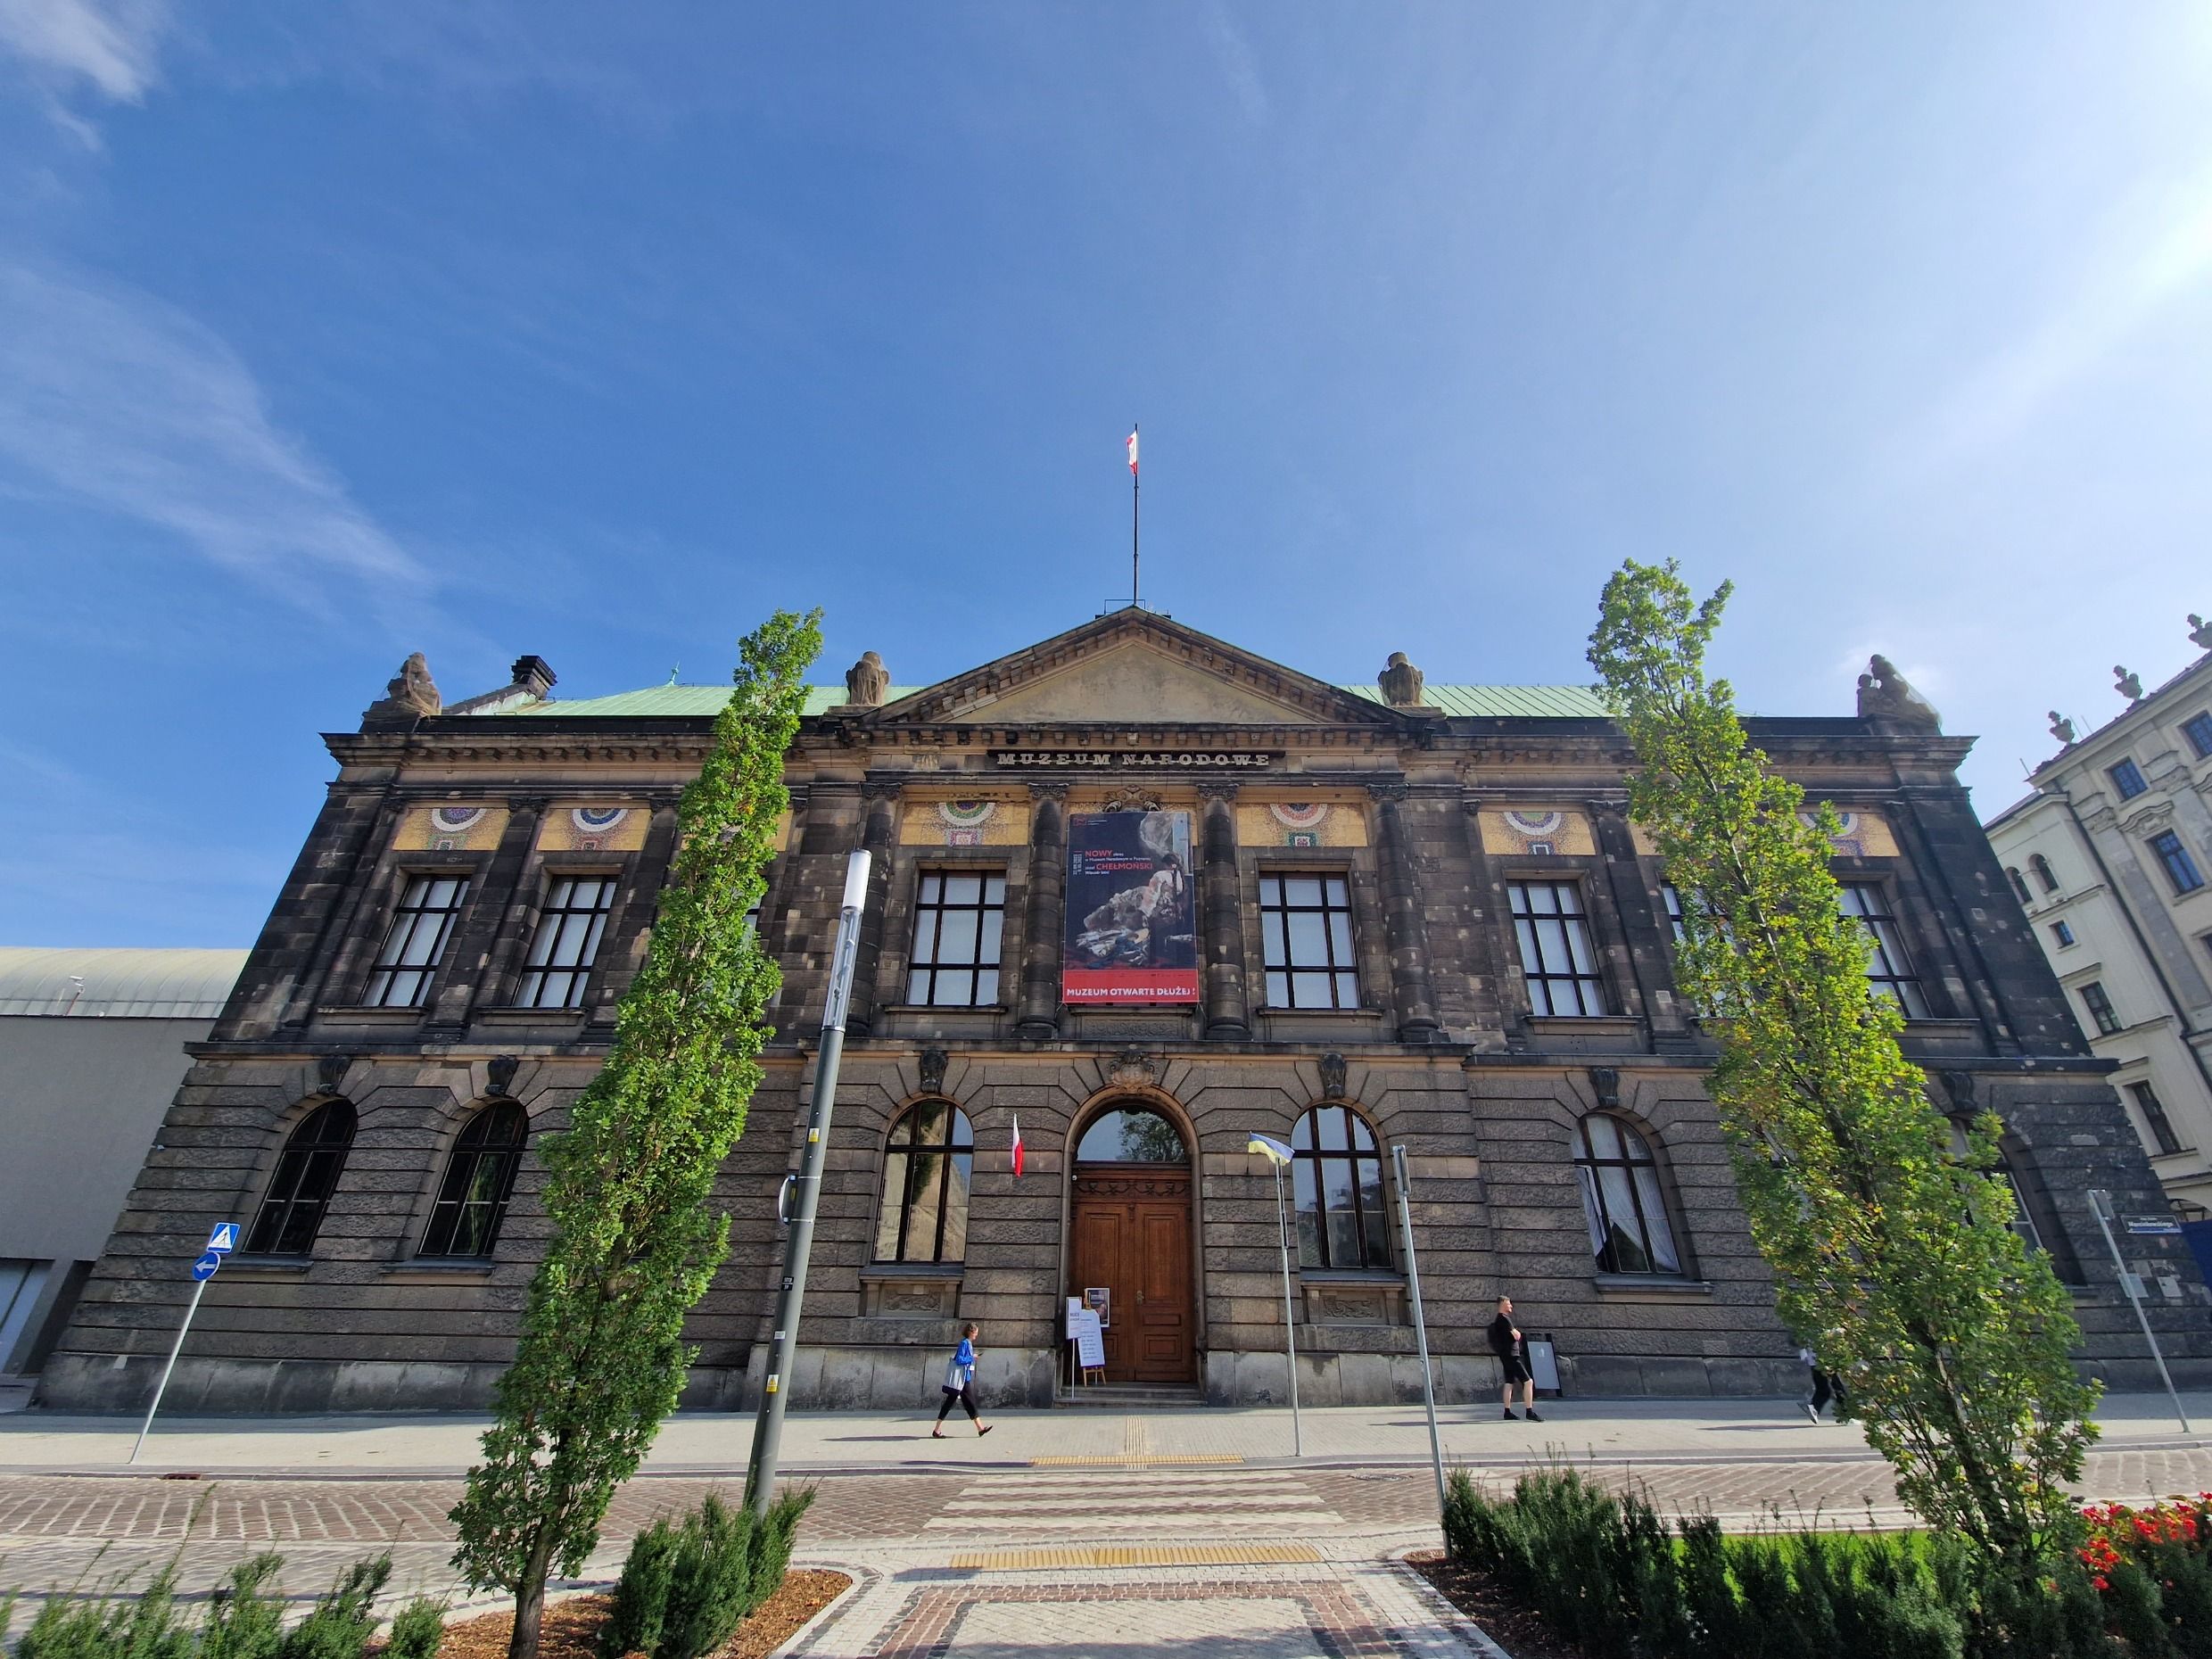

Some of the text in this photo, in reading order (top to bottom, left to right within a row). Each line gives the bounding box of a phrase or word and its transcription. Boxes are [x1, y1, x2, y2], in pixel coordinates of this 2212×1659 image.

[996, 753, 1270, 766] MUZEUM NARODOWE
[1096, 862, 1153, 871] CHEŁMOŃSKI
[1067, 987, 1108, 996] MUZEUM
[1110, 987, 1155, 996] OTWARTE
[1157, 986, 1191, 996] DŁUŻEJ
